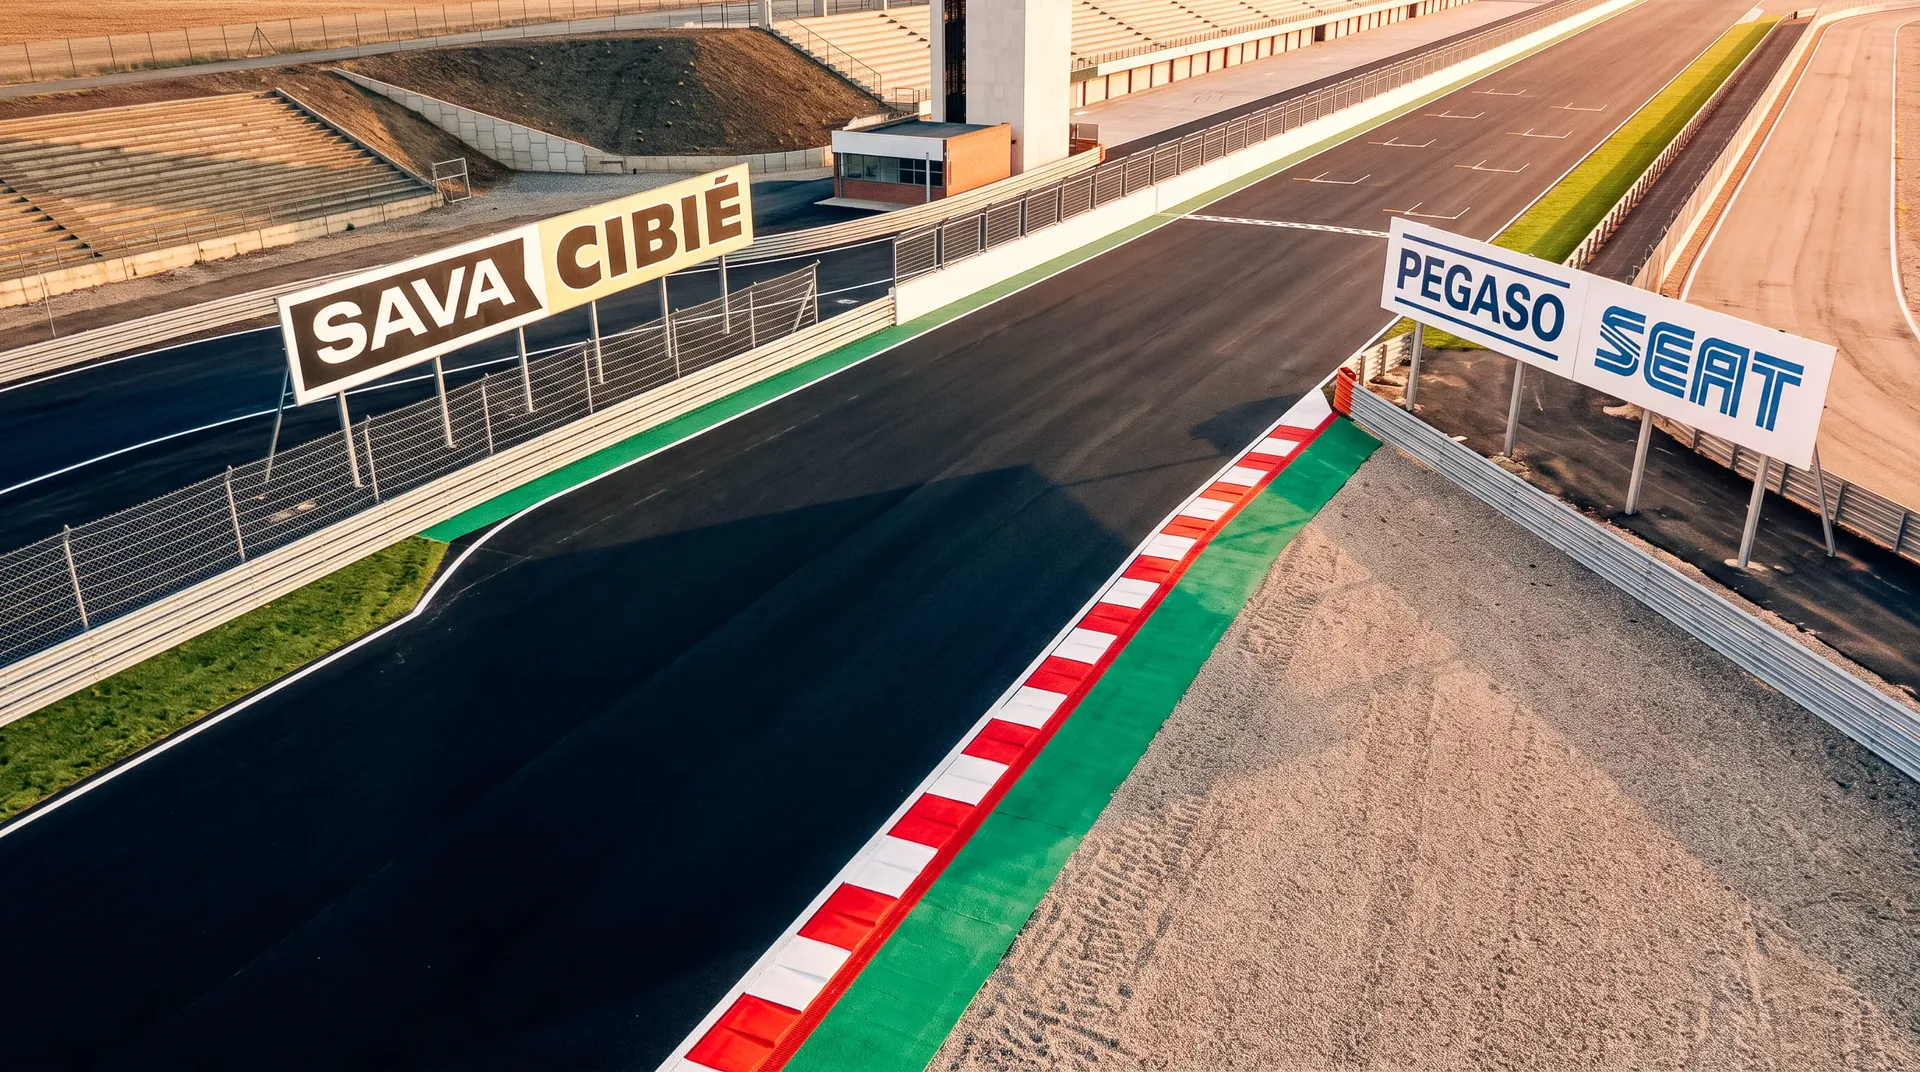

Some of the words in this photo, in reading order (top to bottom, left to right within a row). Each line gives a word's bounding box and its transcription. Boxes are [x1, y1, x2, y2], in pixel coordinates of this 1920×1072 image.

[556, 174, 742, 290] CIBIÉ
[313, 258, 516, 365] SAVA
[1397, 248, 1566, 342] PEGASO
[1594, 305, 1804, 432] SEAT
